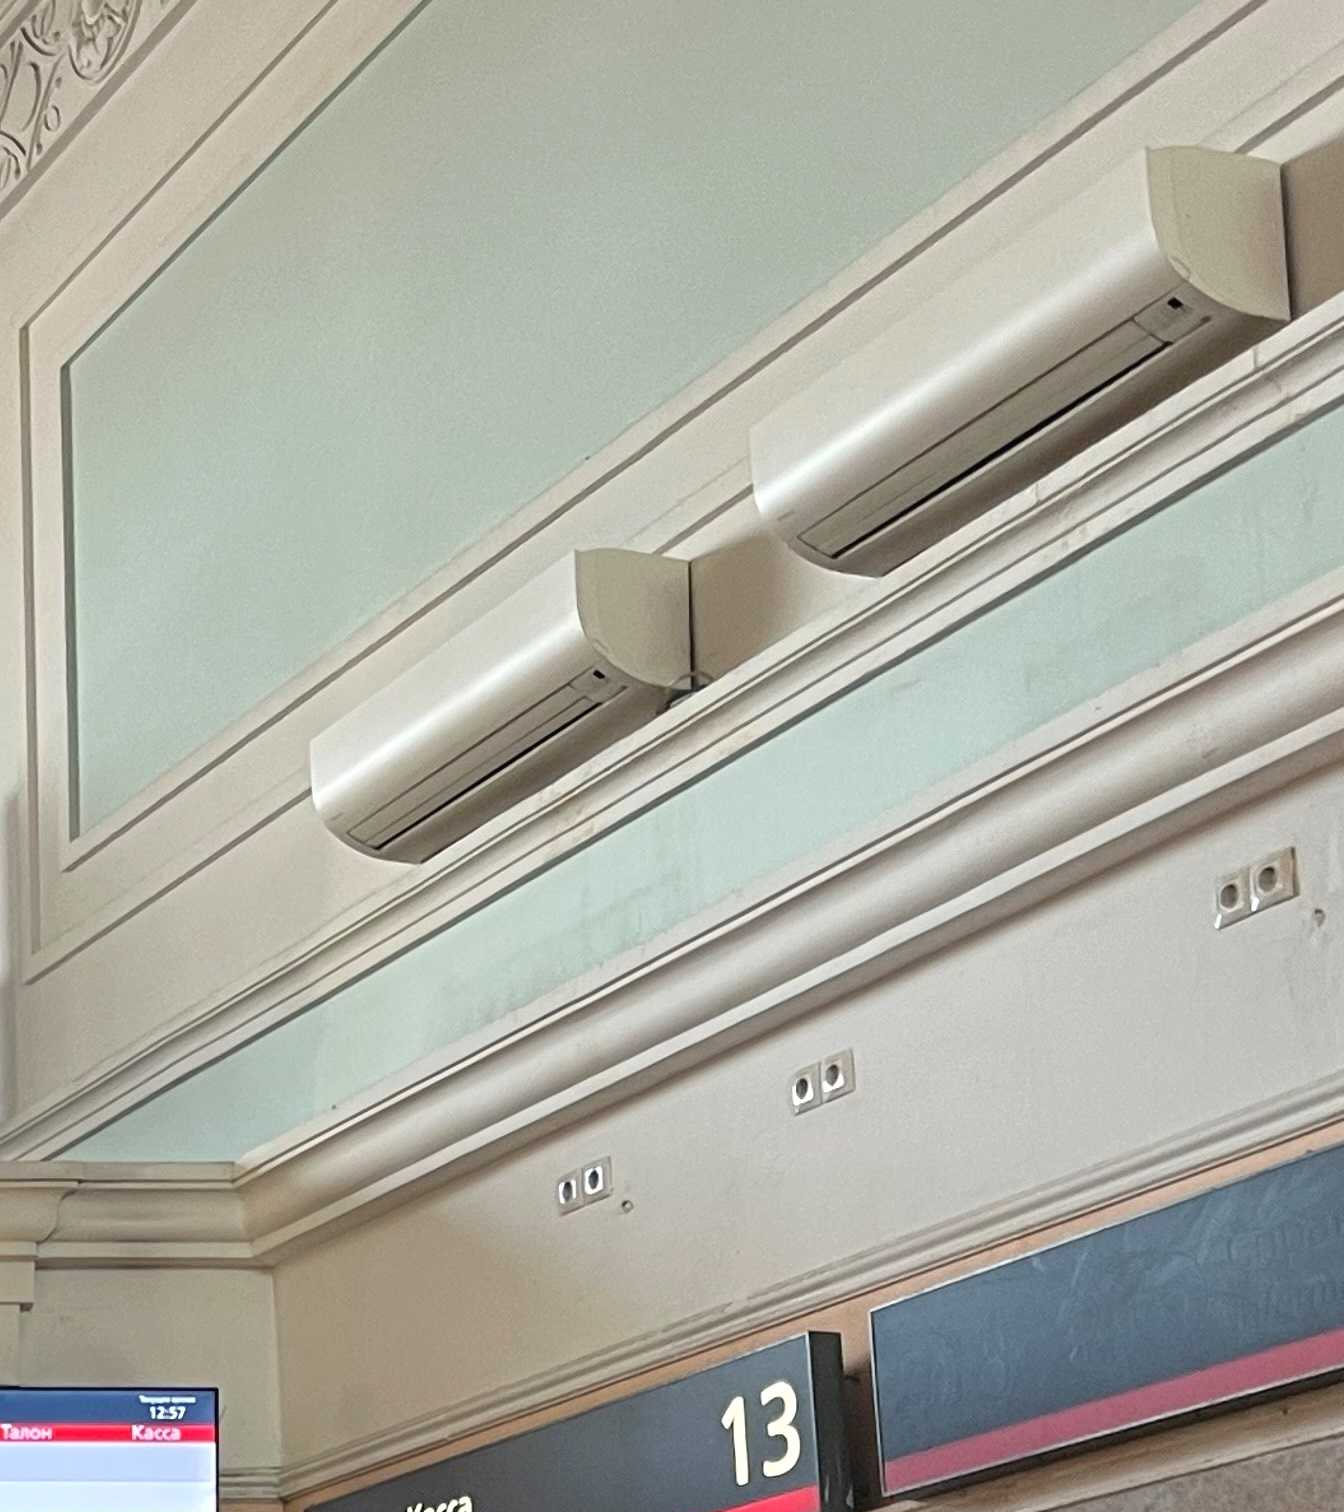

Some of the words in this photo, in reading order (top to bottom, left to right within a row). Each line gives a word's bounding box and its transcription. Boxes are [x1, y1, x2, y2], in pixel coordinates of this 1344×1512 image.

[0, 1424, 52, 1440] Талон
[132, 1424, 181, 1440] Касса
[720, 1381, 802, 1486] 13
